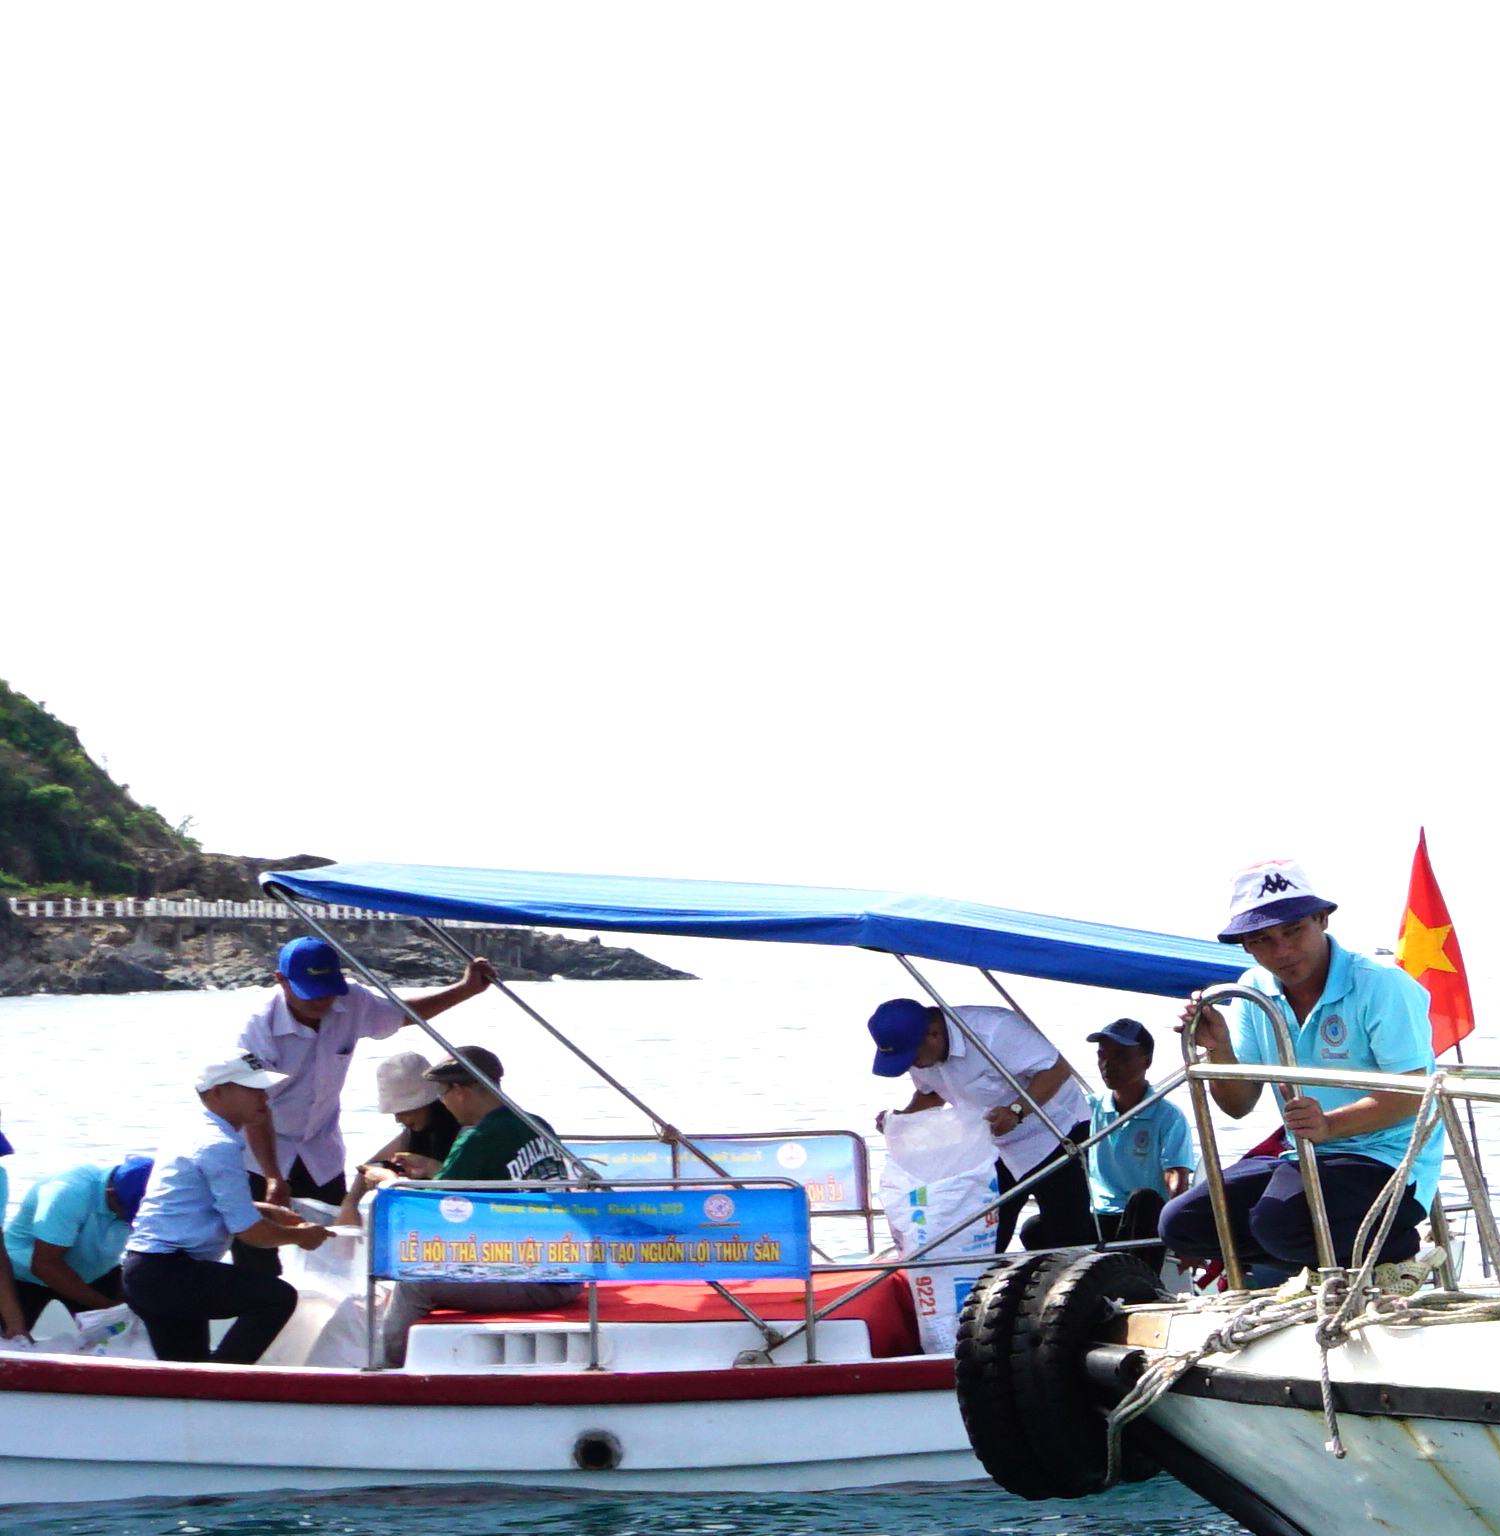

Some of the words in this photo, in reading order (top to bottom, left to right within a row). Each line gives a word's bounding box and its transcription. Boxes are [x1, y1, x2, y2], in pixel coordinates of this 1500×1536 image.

[400, 1230, 418, 1263] LỄ
[422, 1236, 447, 1268] HỘI
[449, 1233, 478, 1263] THẢ
[480, 1241, 513, 1263] SINH
[516, 1236, 543, 1268] VẬT
[547, 1231, 580, 1263] BIỂN
[583, 1236, 606, 1263] TÁI
[608, 1241, 636, 1268] TẠO
[639, 1233, 685, 1263] NGUỒN
[688, 1239, 711, 1267] LỢI
[713, 1233, 750, 1263] THỦY
[753, 1233, 781, 1263] SẢN
